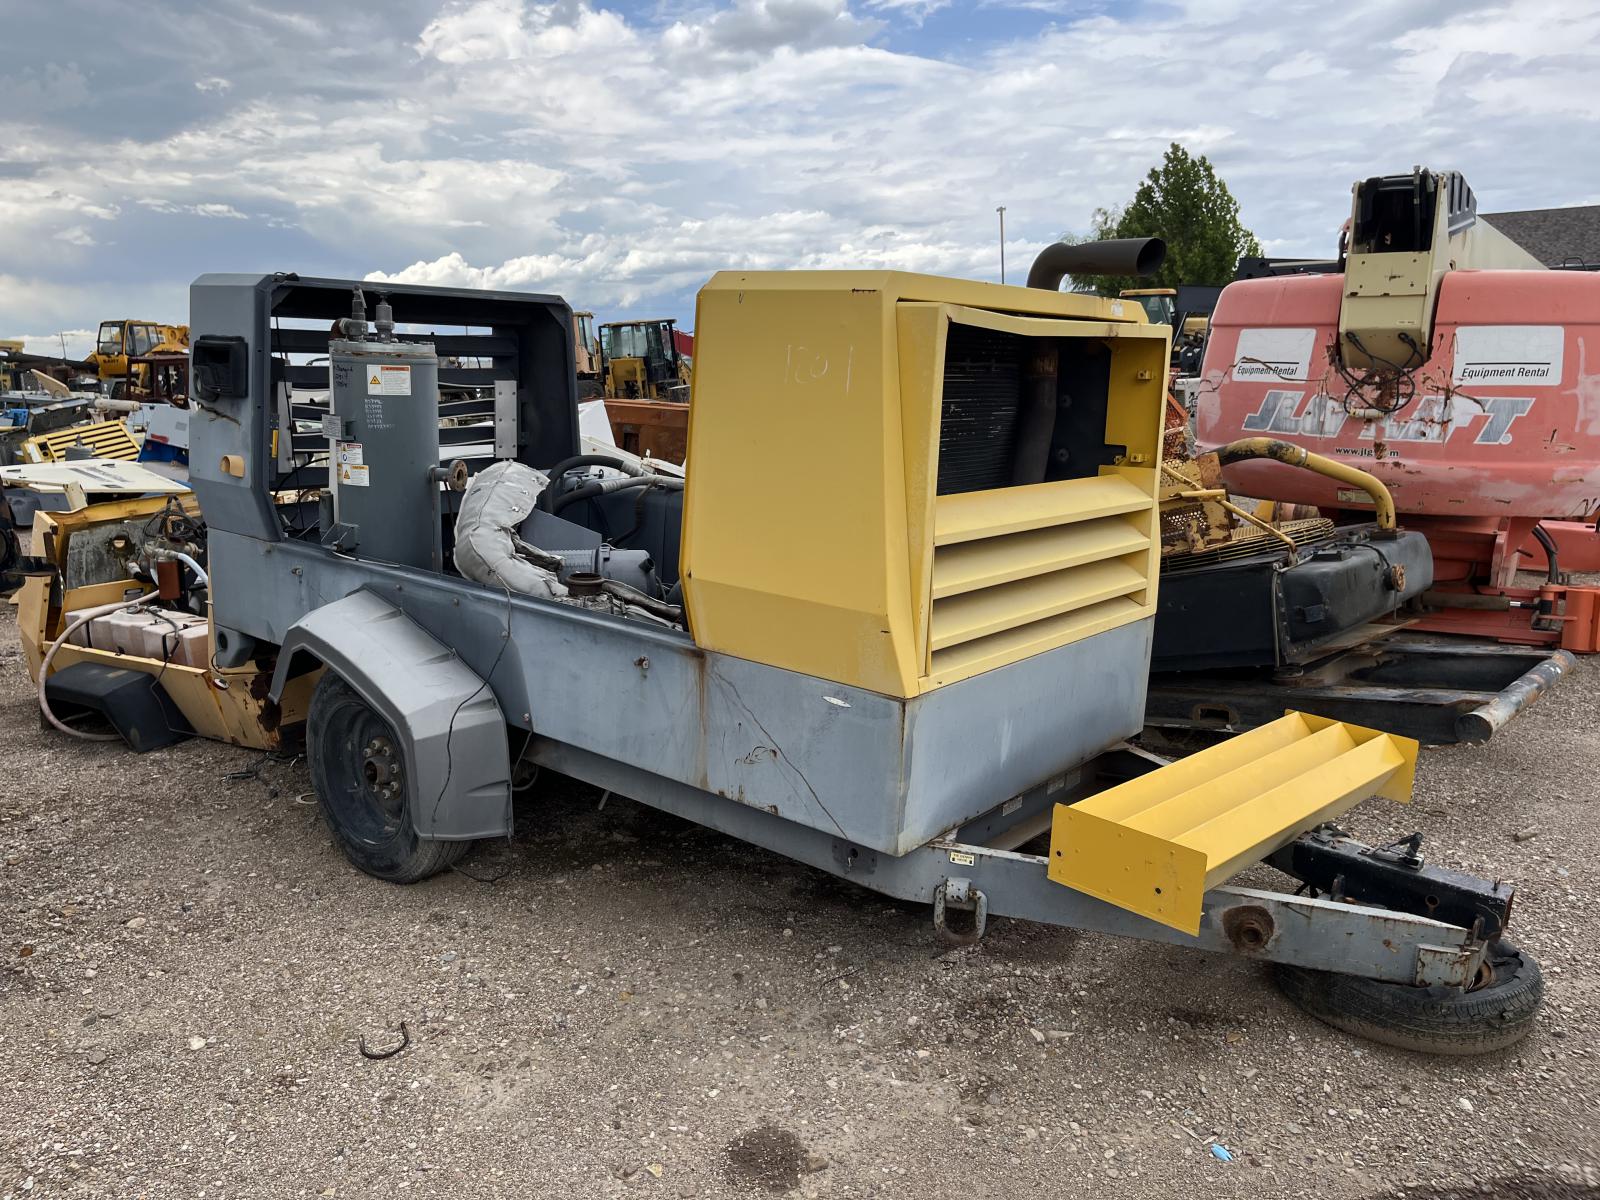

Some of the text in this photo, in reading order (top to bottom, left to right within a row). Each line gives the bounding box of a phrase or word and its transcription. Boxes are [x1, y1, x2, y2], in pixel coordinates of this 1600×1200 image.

[1237, 365, 1298, 376] Equipment Rental
[1462, 367, 1550, 379] Equipment Rental
